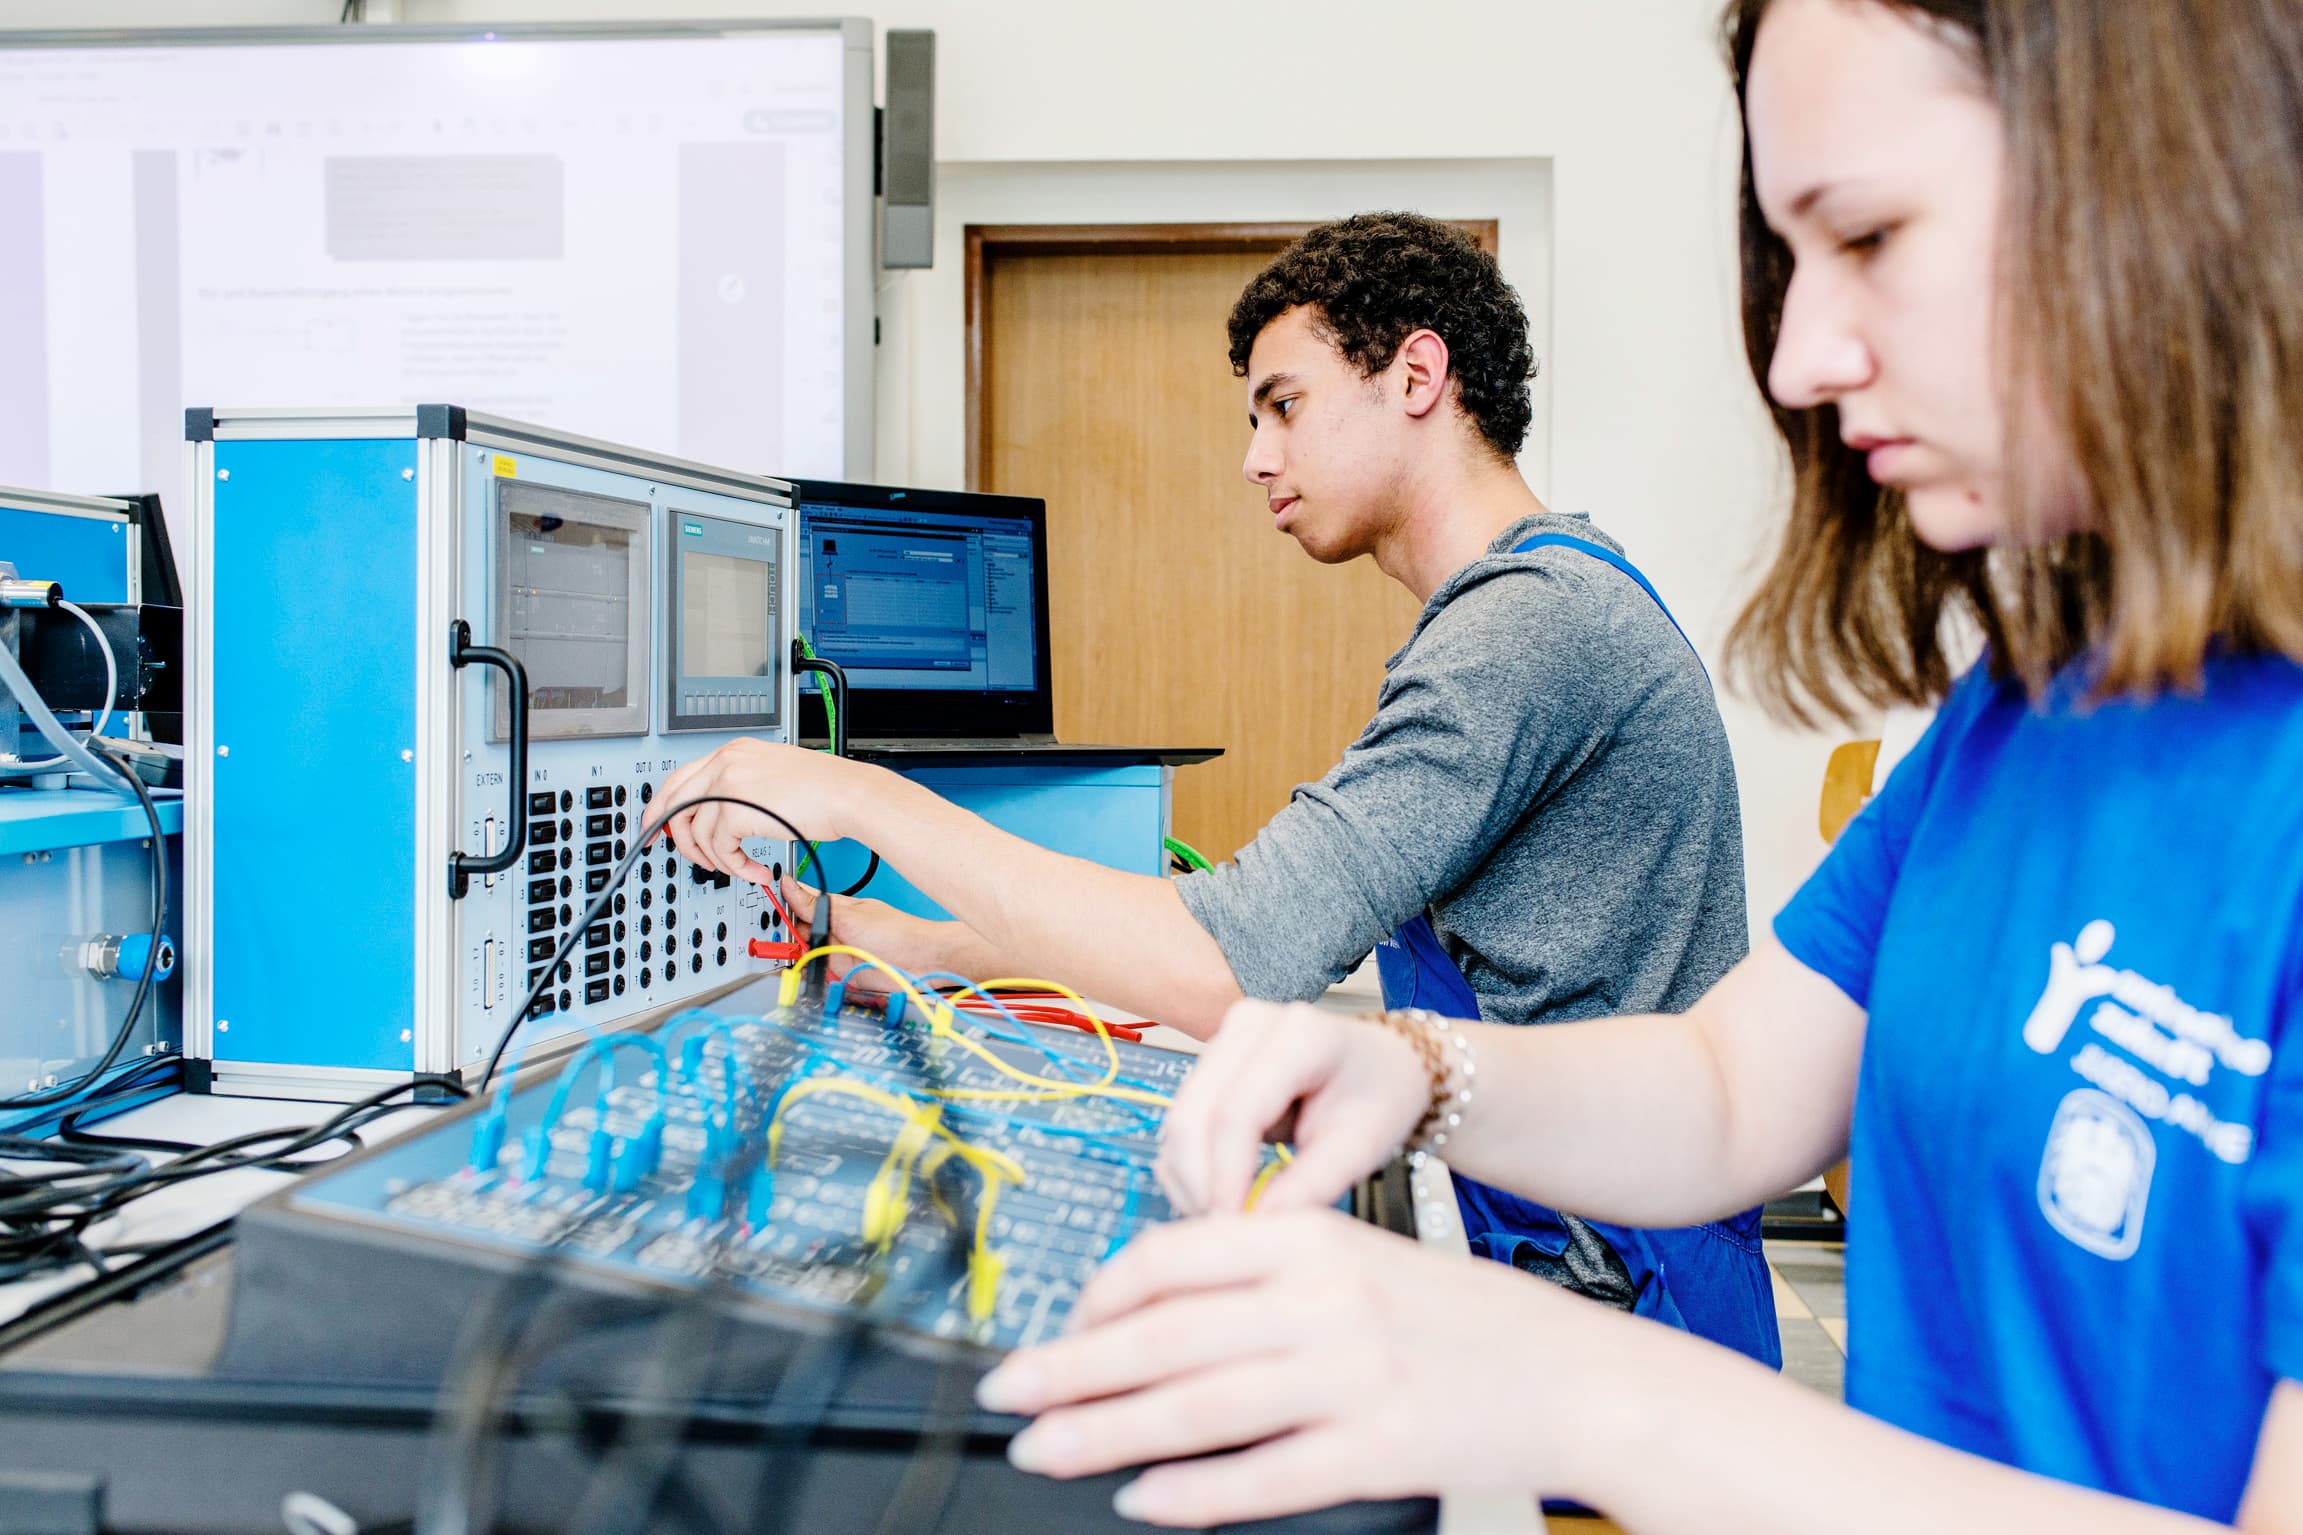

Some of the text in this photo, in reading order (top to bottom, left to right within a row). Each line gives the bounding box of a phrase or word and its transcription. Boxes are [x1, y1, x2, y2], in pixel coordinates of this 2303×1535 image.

[768, 566, 777, 616] TOUCH
[636, 762, 646, 773] OUT
[661, 760, 672, 771] OUT
[534, 770, 541, 781] IN
[592, 766, 598, 777] IN
[476, 773, 503, 786] EXTERN
